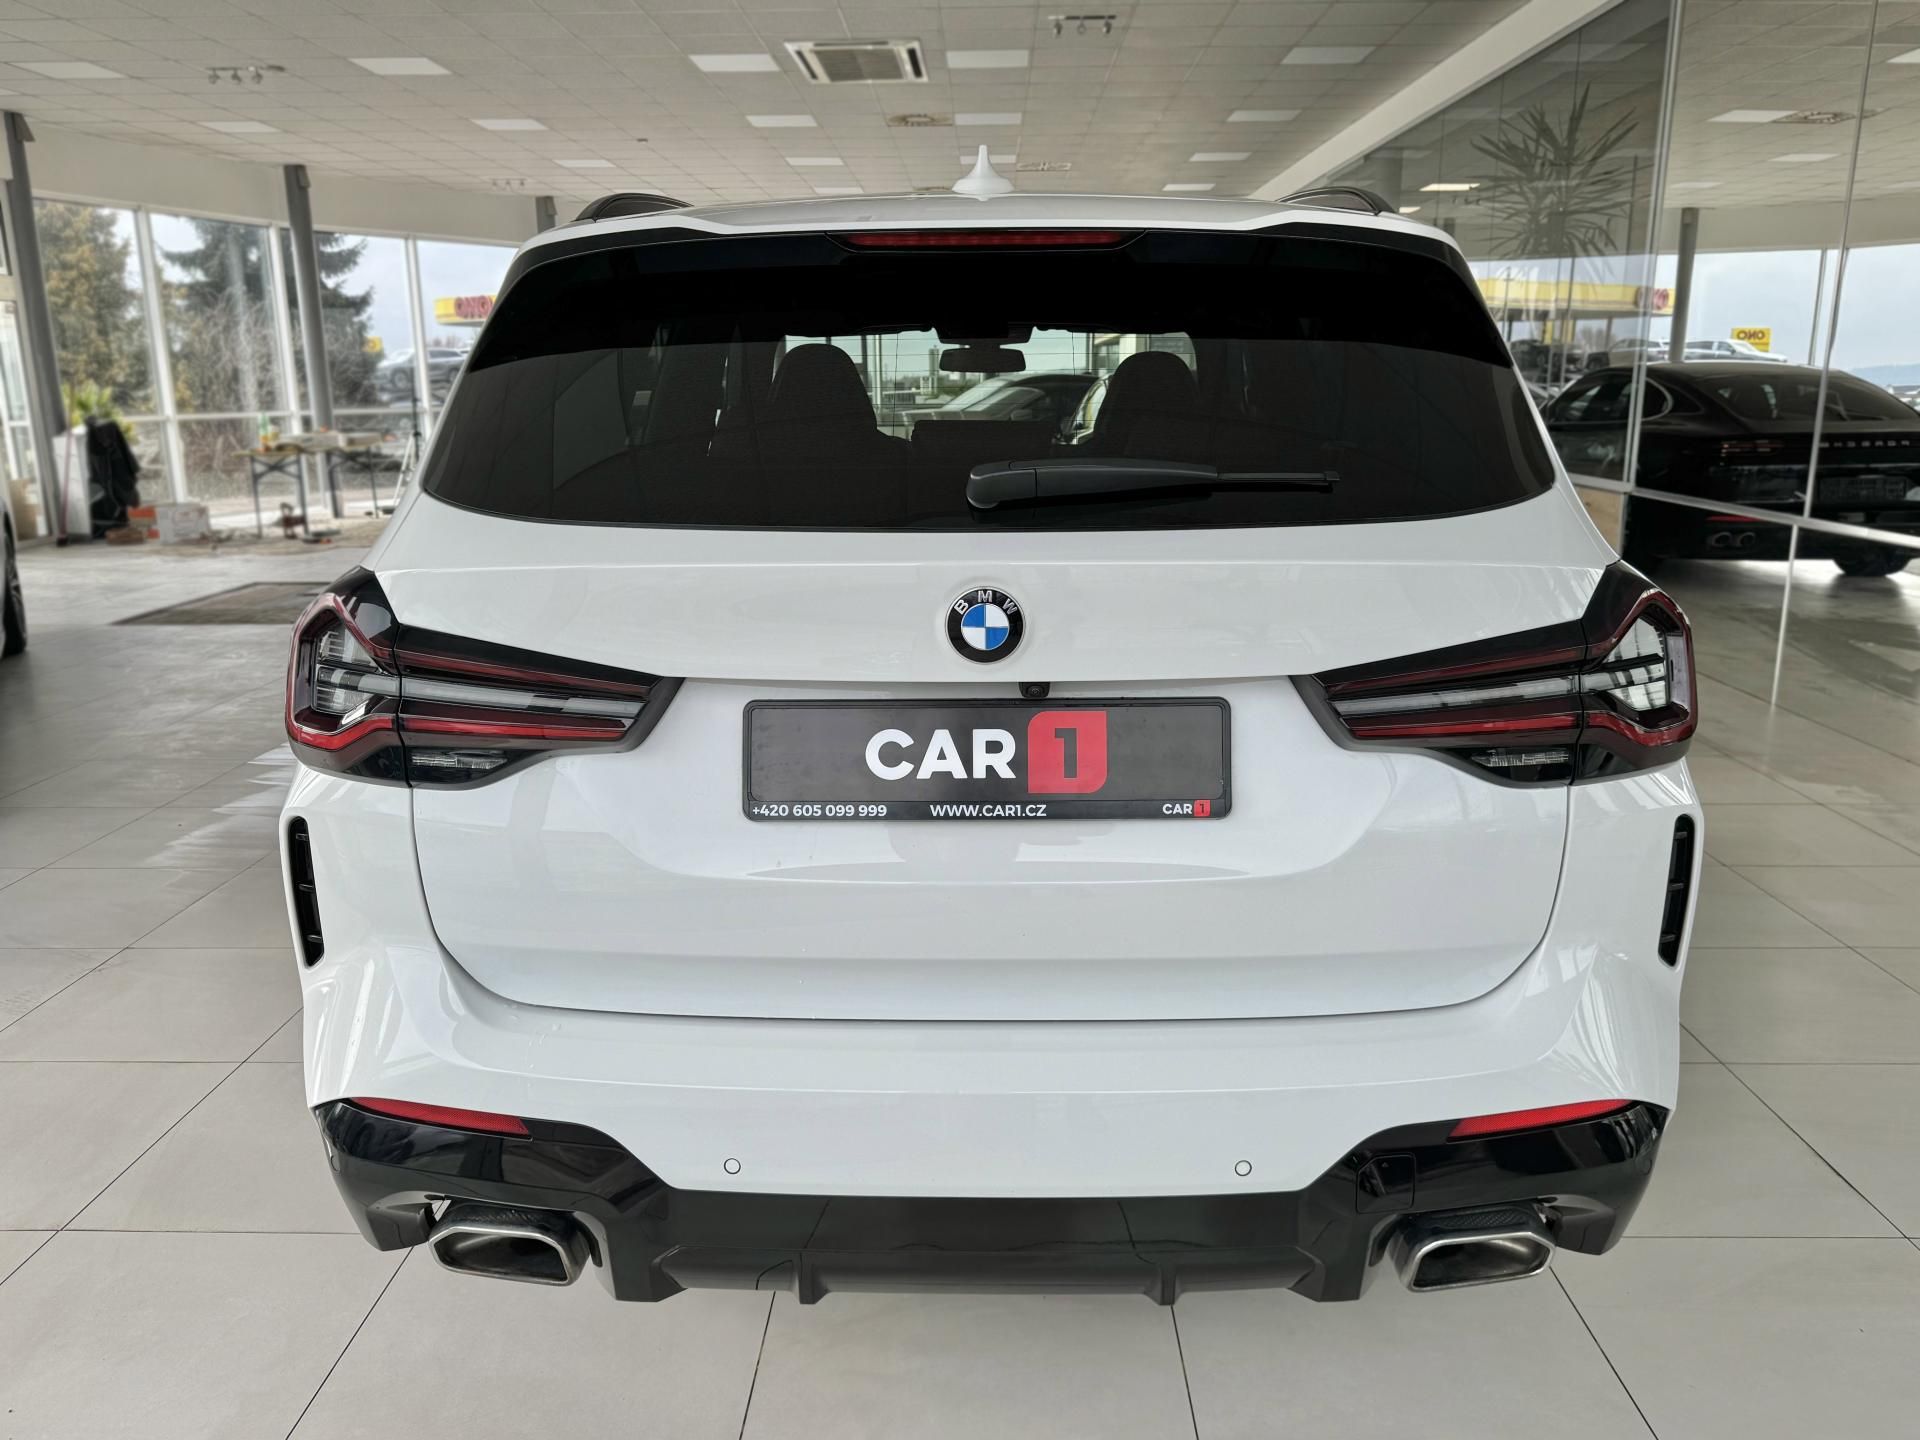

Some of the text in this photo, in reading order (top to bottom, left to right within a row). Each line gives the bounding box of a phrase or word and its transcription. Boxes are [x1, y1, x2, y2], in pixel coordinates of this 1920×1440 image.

[954, 590, 1018, 615] BMW
[865, 727, 1078, 781] CAR 1
[752, 804, 887, 816] +420 605 099 999
[929, 804, 1047, 817] WWW.CAR1.CZ
[1162, 803, 1193, 815] CAR
